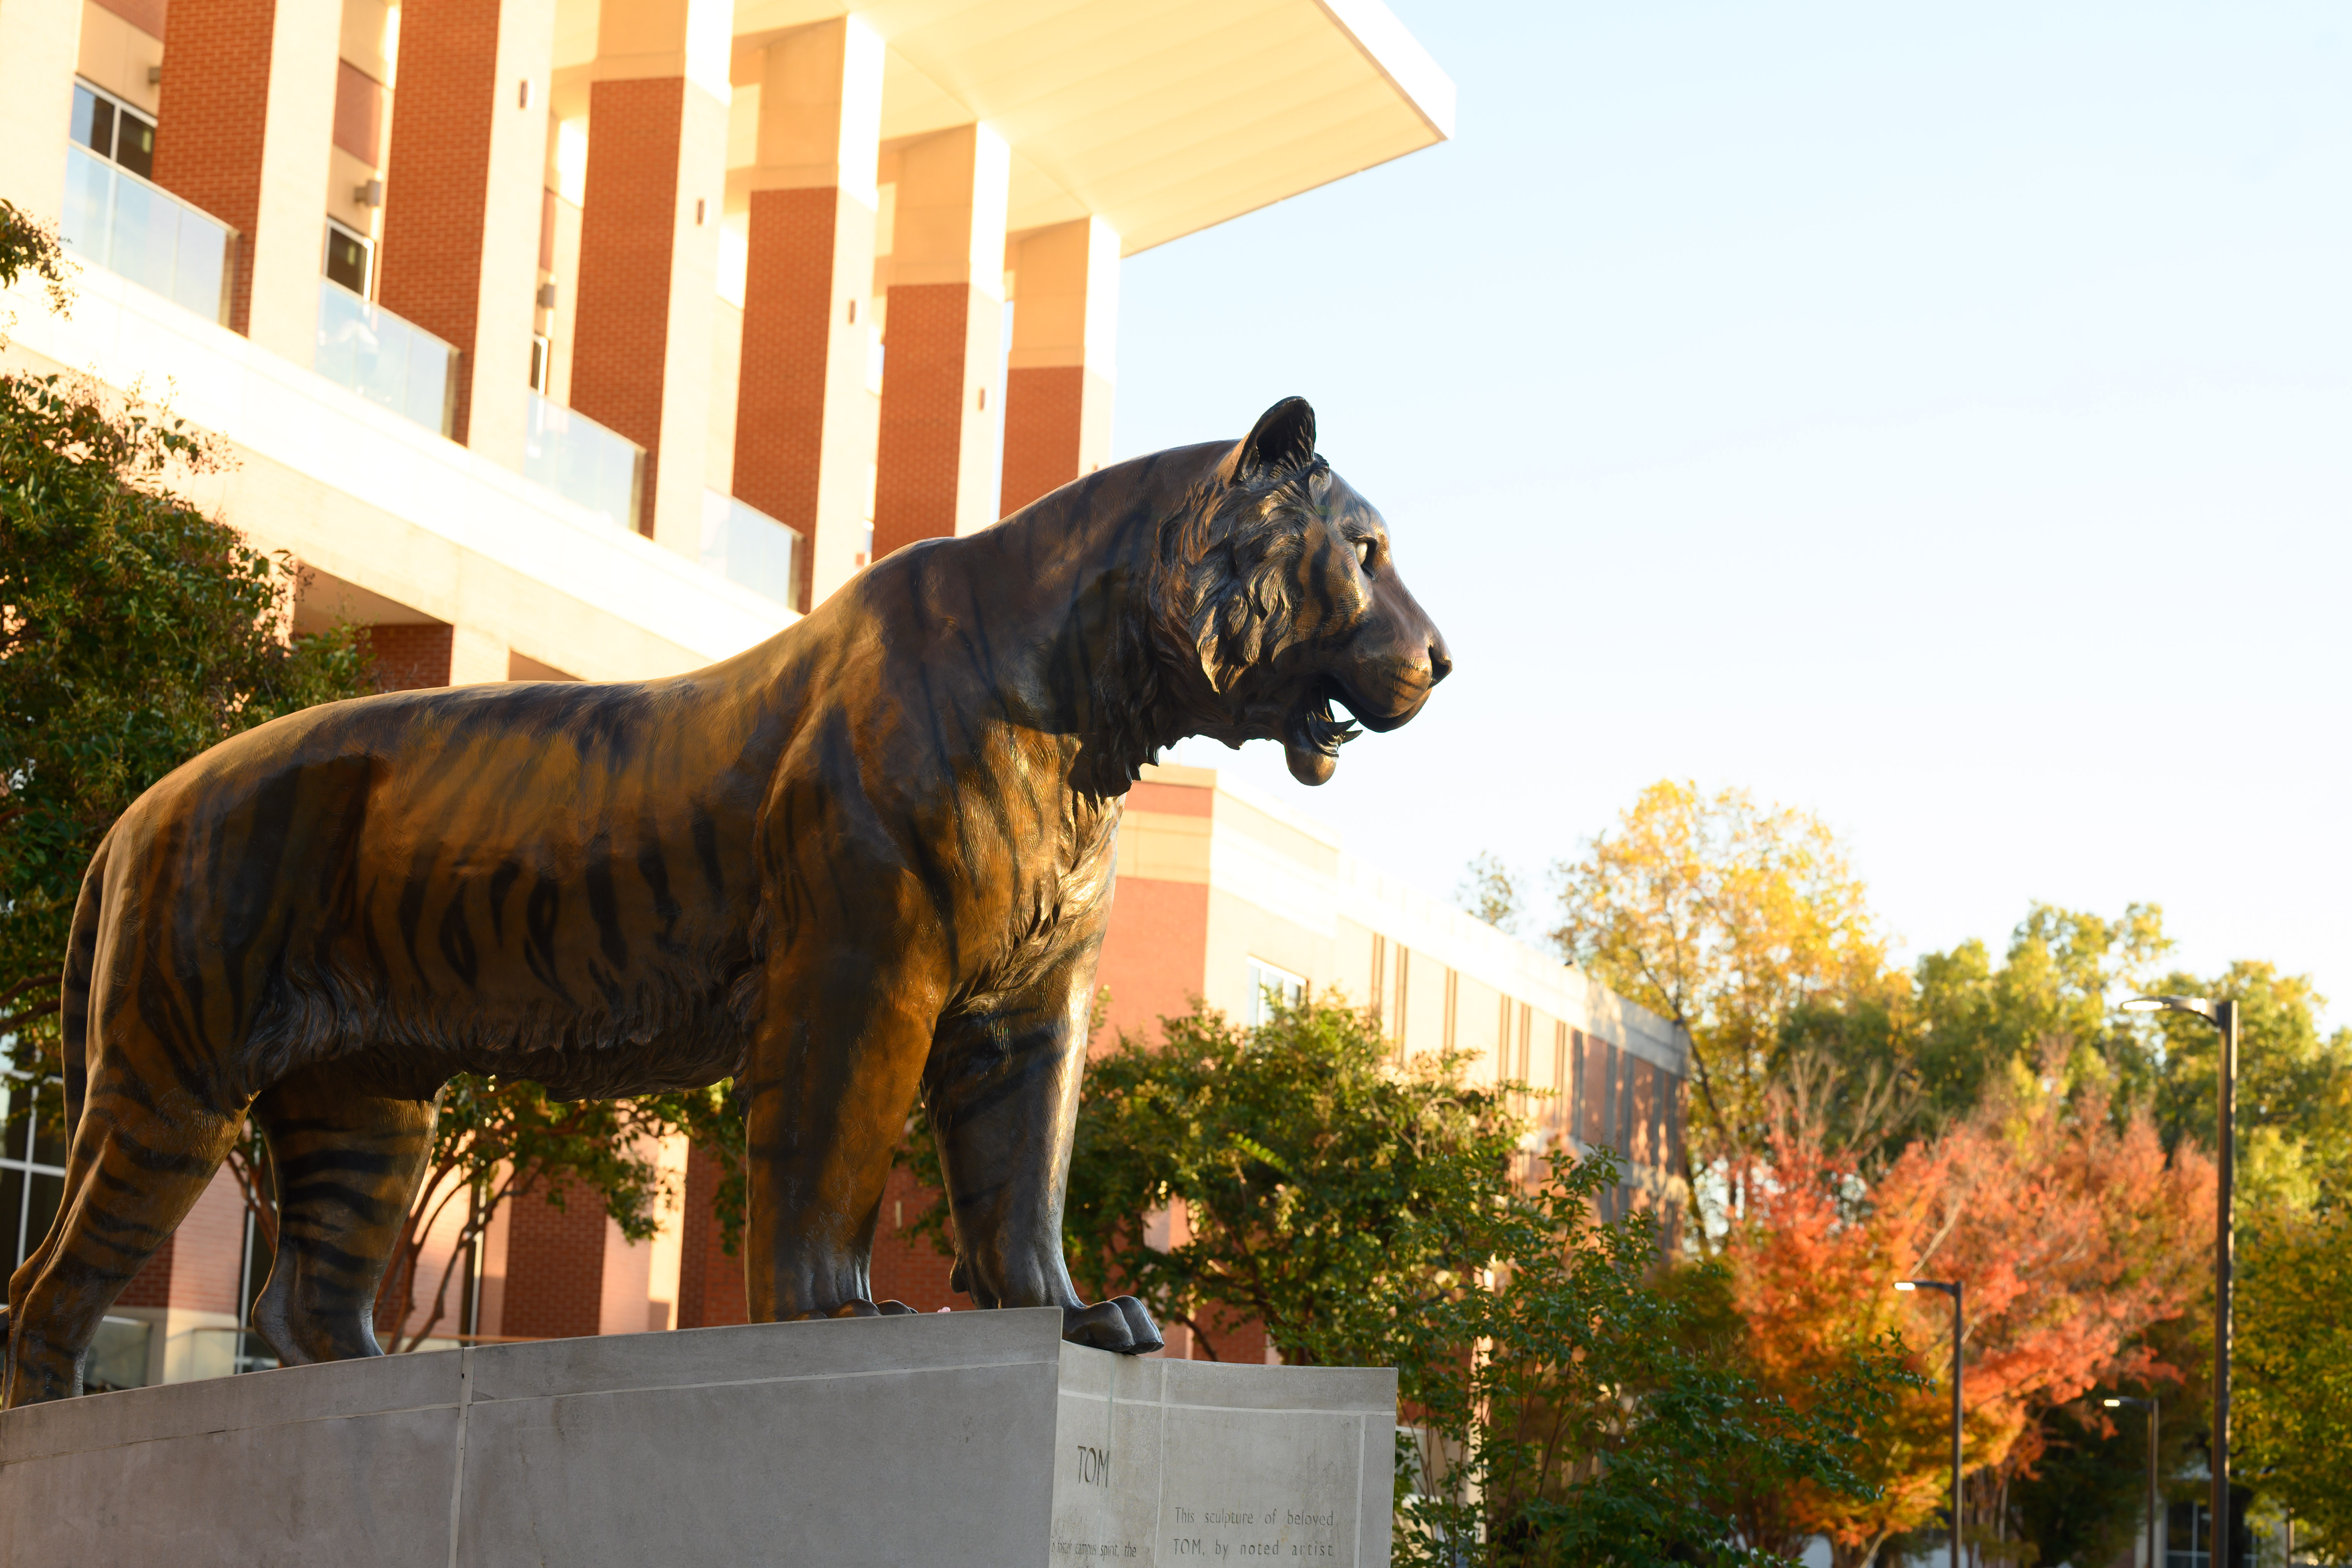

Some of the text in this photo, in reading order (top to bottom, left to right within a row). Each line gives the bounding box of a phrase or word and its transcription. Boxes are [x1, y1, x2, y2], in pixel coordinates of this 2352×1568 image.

[1077, 1445, 1110, 1488] TOM
[1175, 1507, 1333, 1529] This sculpture of beloved
[1075, 1542, 1097, 1561] campus
[1100, 1541, 1119, 1562] spirit,
[1124, 1541, 1136, 1557] the
[1173, 1538, 1333, 1560] TOM, by noted artist
